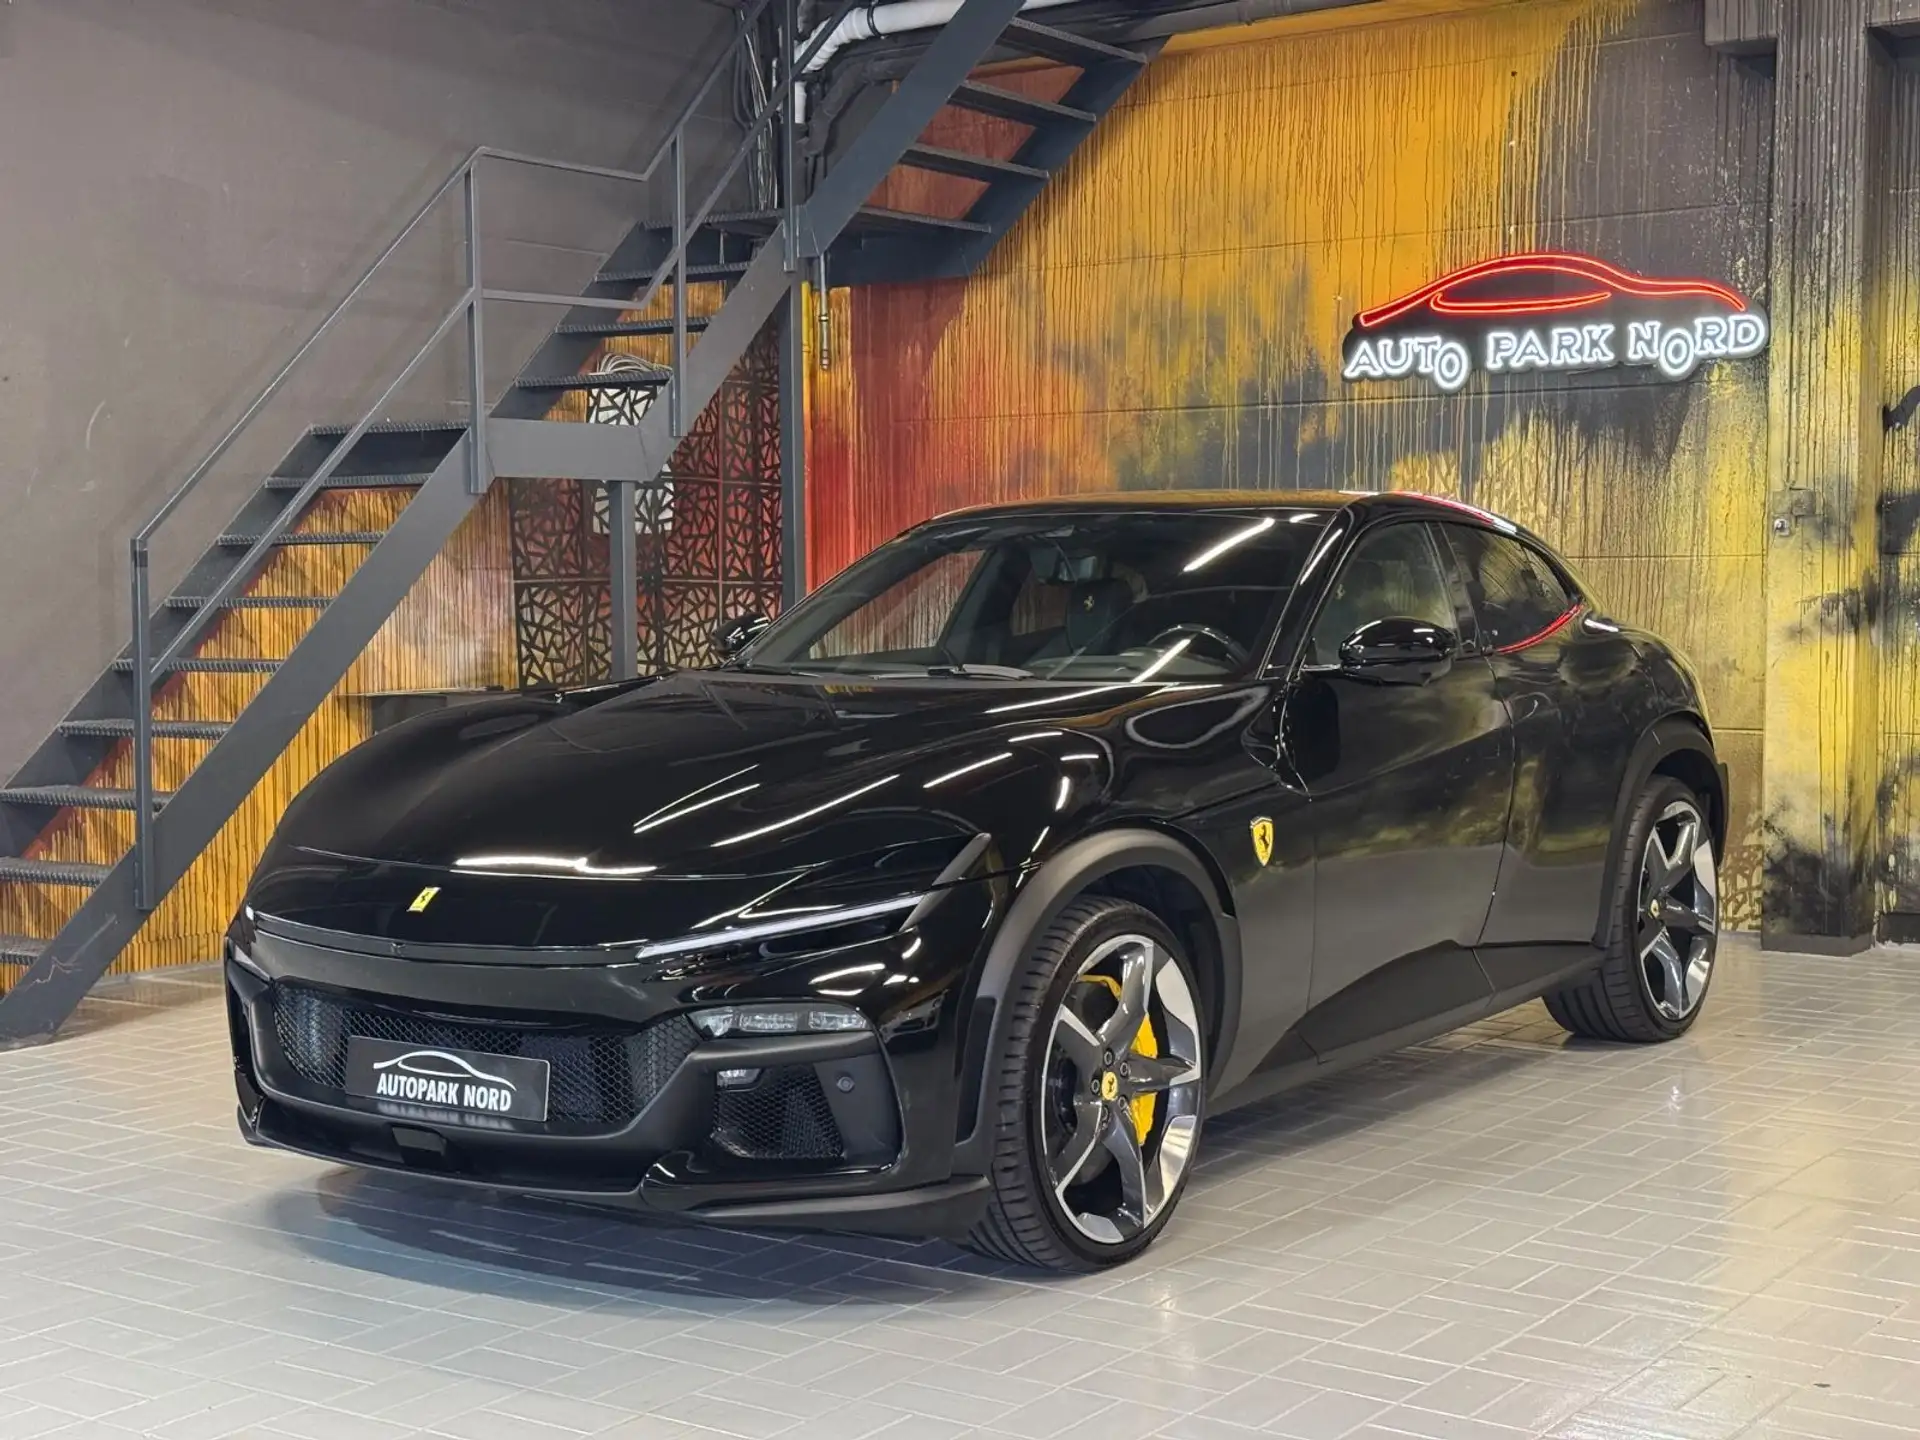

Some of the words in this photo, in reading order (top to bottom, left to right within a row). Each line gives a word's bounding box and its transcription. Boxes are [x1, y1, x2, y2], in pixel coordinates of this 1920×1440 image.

[1343, 335, 1470, 390] AUTO
[1485, 323, 1614, 369] PARK
[1627, 312, 1768, 377] NORD
[376, 1073, 459, 1105] AUTOPARK
[463, 1085, 512, 1111] NORD
